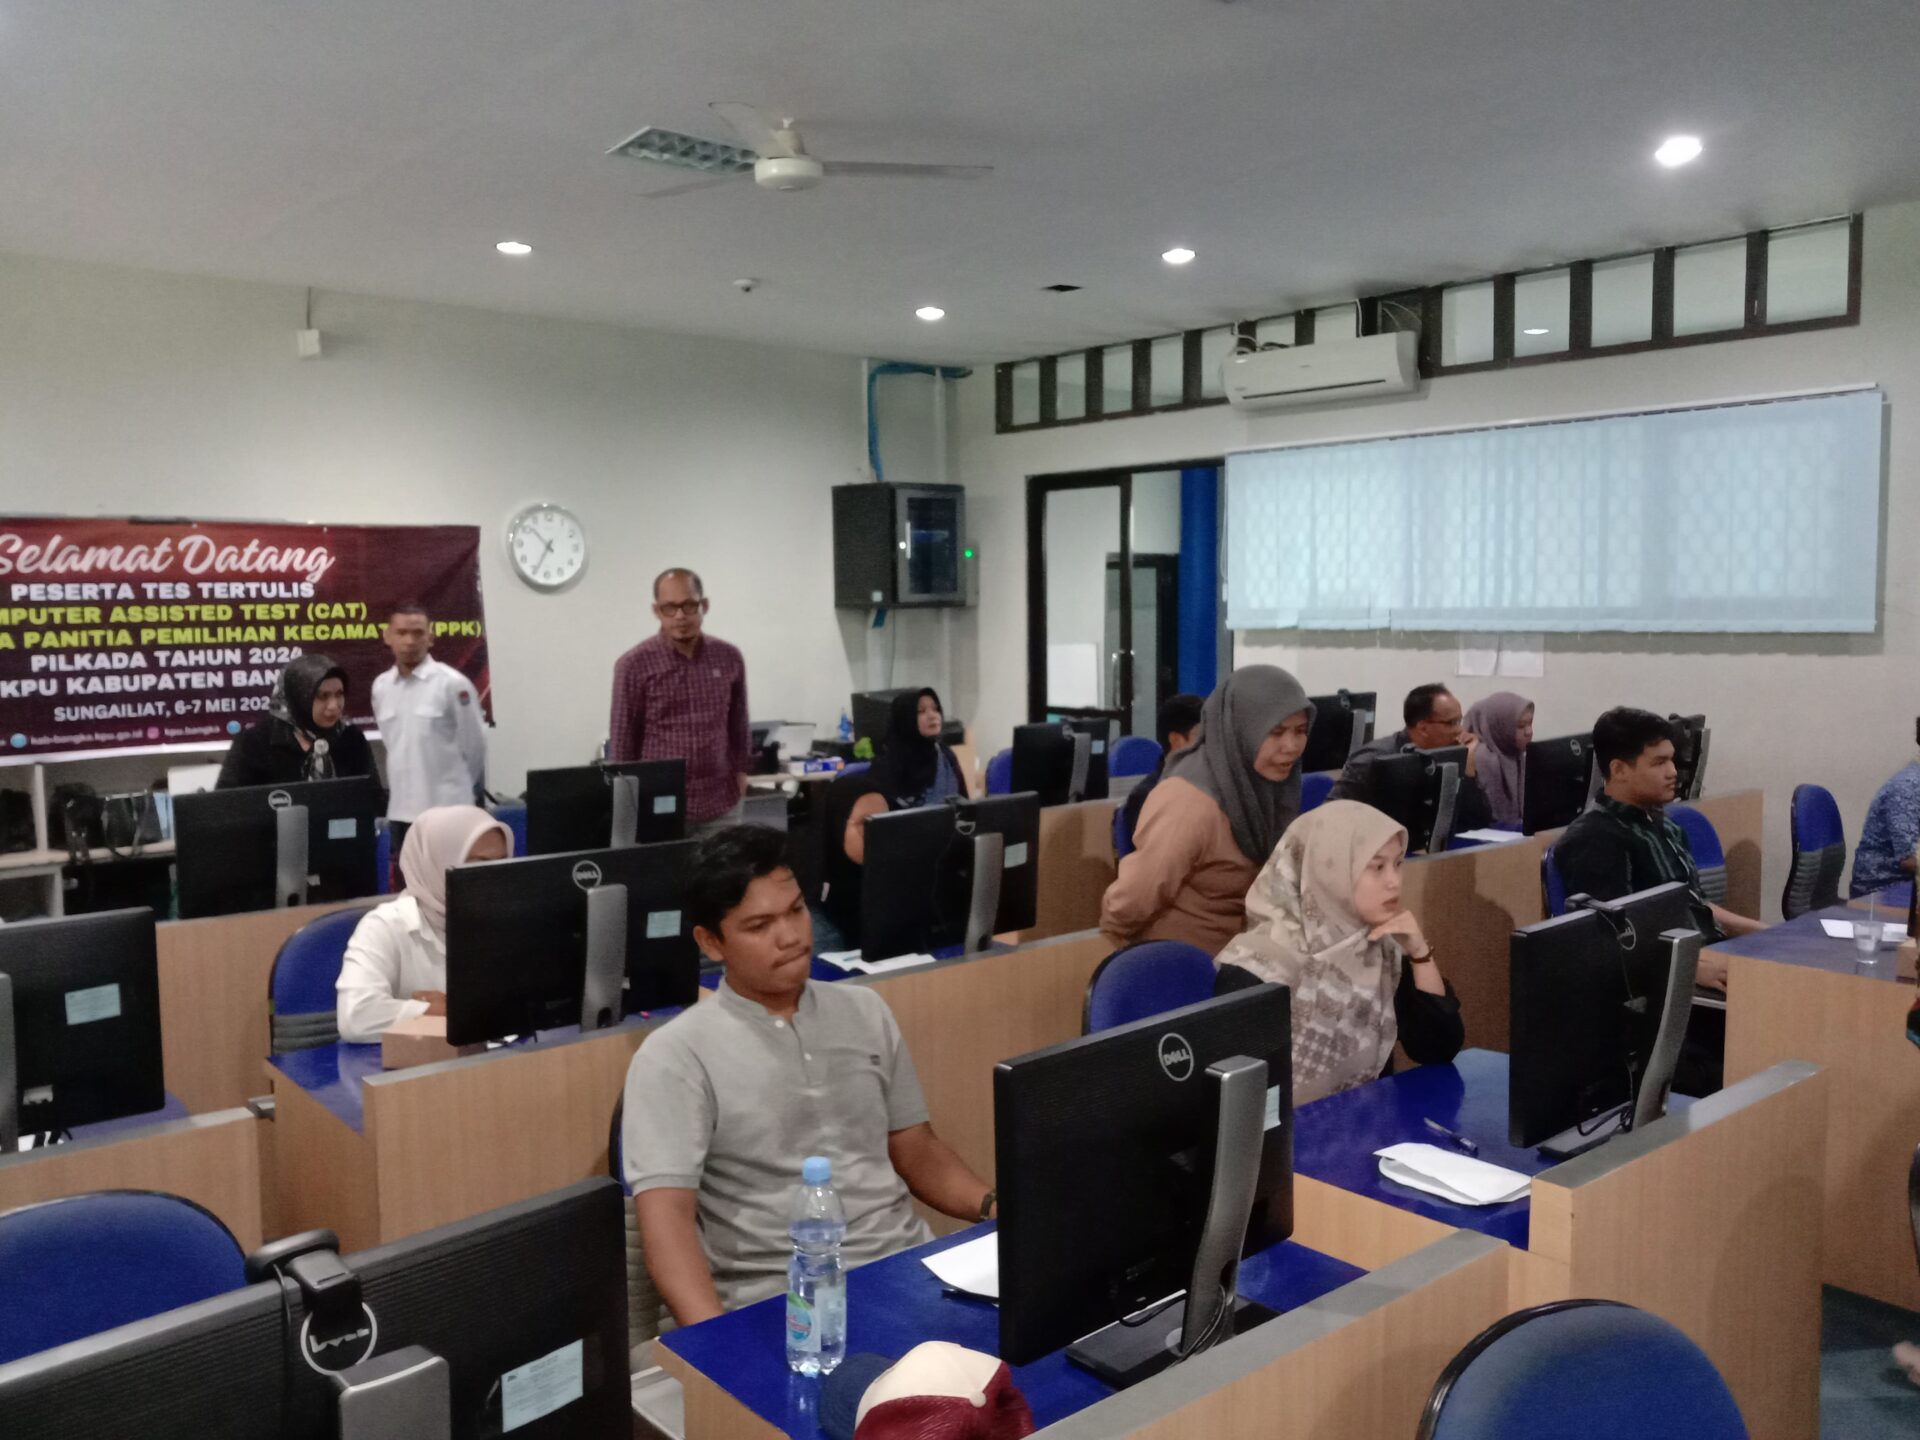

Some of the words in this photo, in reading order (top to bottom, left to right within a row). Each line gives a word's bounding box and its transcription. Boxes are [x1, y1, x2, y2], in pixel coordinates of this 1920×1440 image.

[0, 533, 174, 575] Selamat
[178, 534, 336, 584] Datang
[11, 582, 135, 601] PESERTA
[141, 582, 191, 600] TES
[197, 581, 315, 599] TERTULIS
[109, 604, 233, 623] ASSISTED
[239, 603, 300, 621] TEST
[306, 602, 368, 622] (CAT)
[23, 629, 134, 649] PANITIA
[141, 626, 277, 645] PEMILIHAN
[429, 620, 482, 638] (PPK)
[31, 651, 148, 673] PILKADA
[153, 648, 242, 668] TAHUN
[0, 678, 59, 698] KPU
[66, 671, 225, 695] KABUPATEN
[54, 701, 171, 722] SUNGAILIAT,
[174, 699, 202, 716] 6-7
[205, 697, 236, 713] MEI
